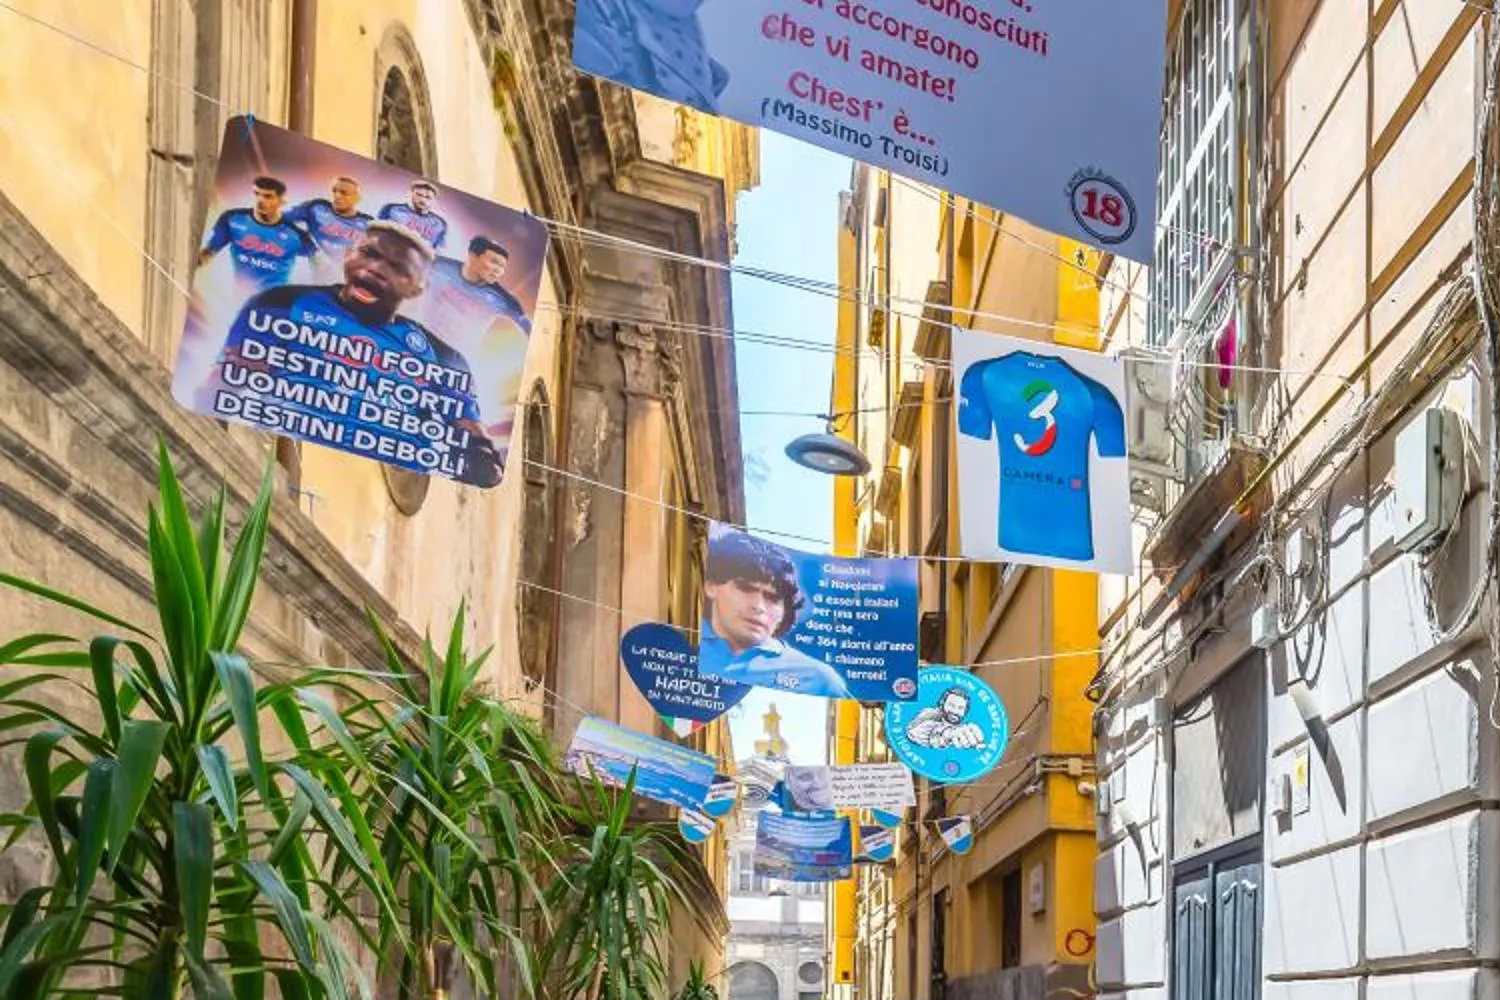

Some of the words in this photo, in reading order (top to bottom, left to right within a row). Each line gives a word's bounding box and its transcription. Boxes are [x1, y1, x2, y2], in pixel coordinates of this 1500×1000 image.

[826, 35, 850, 62] vi
[860, 49, 956, 102] amate!
[836, 0, 979, 69] accorgono
[760, 96, 873, 149] (Massimo
[879, 134, 949, 177] Troisi)
[1081, 187, 1123, 227] 18
[241, 338, 368, 391] DESTINI
[376, 377, 465, 419] FORTI
[248, 309, 373, 363] UOMINI
[381, 350, 470, 391] FORTI
[217, 391, 344, 443] DESTINI
[353, 429, 465, 476] DEBOLI
[223, 362, 349, 415] UOMINI
[358, 401, 470, 449] DEBOLI
[1012, 379, 1060, 457] 3
[655, 674, 721, 700] NAPOLI
